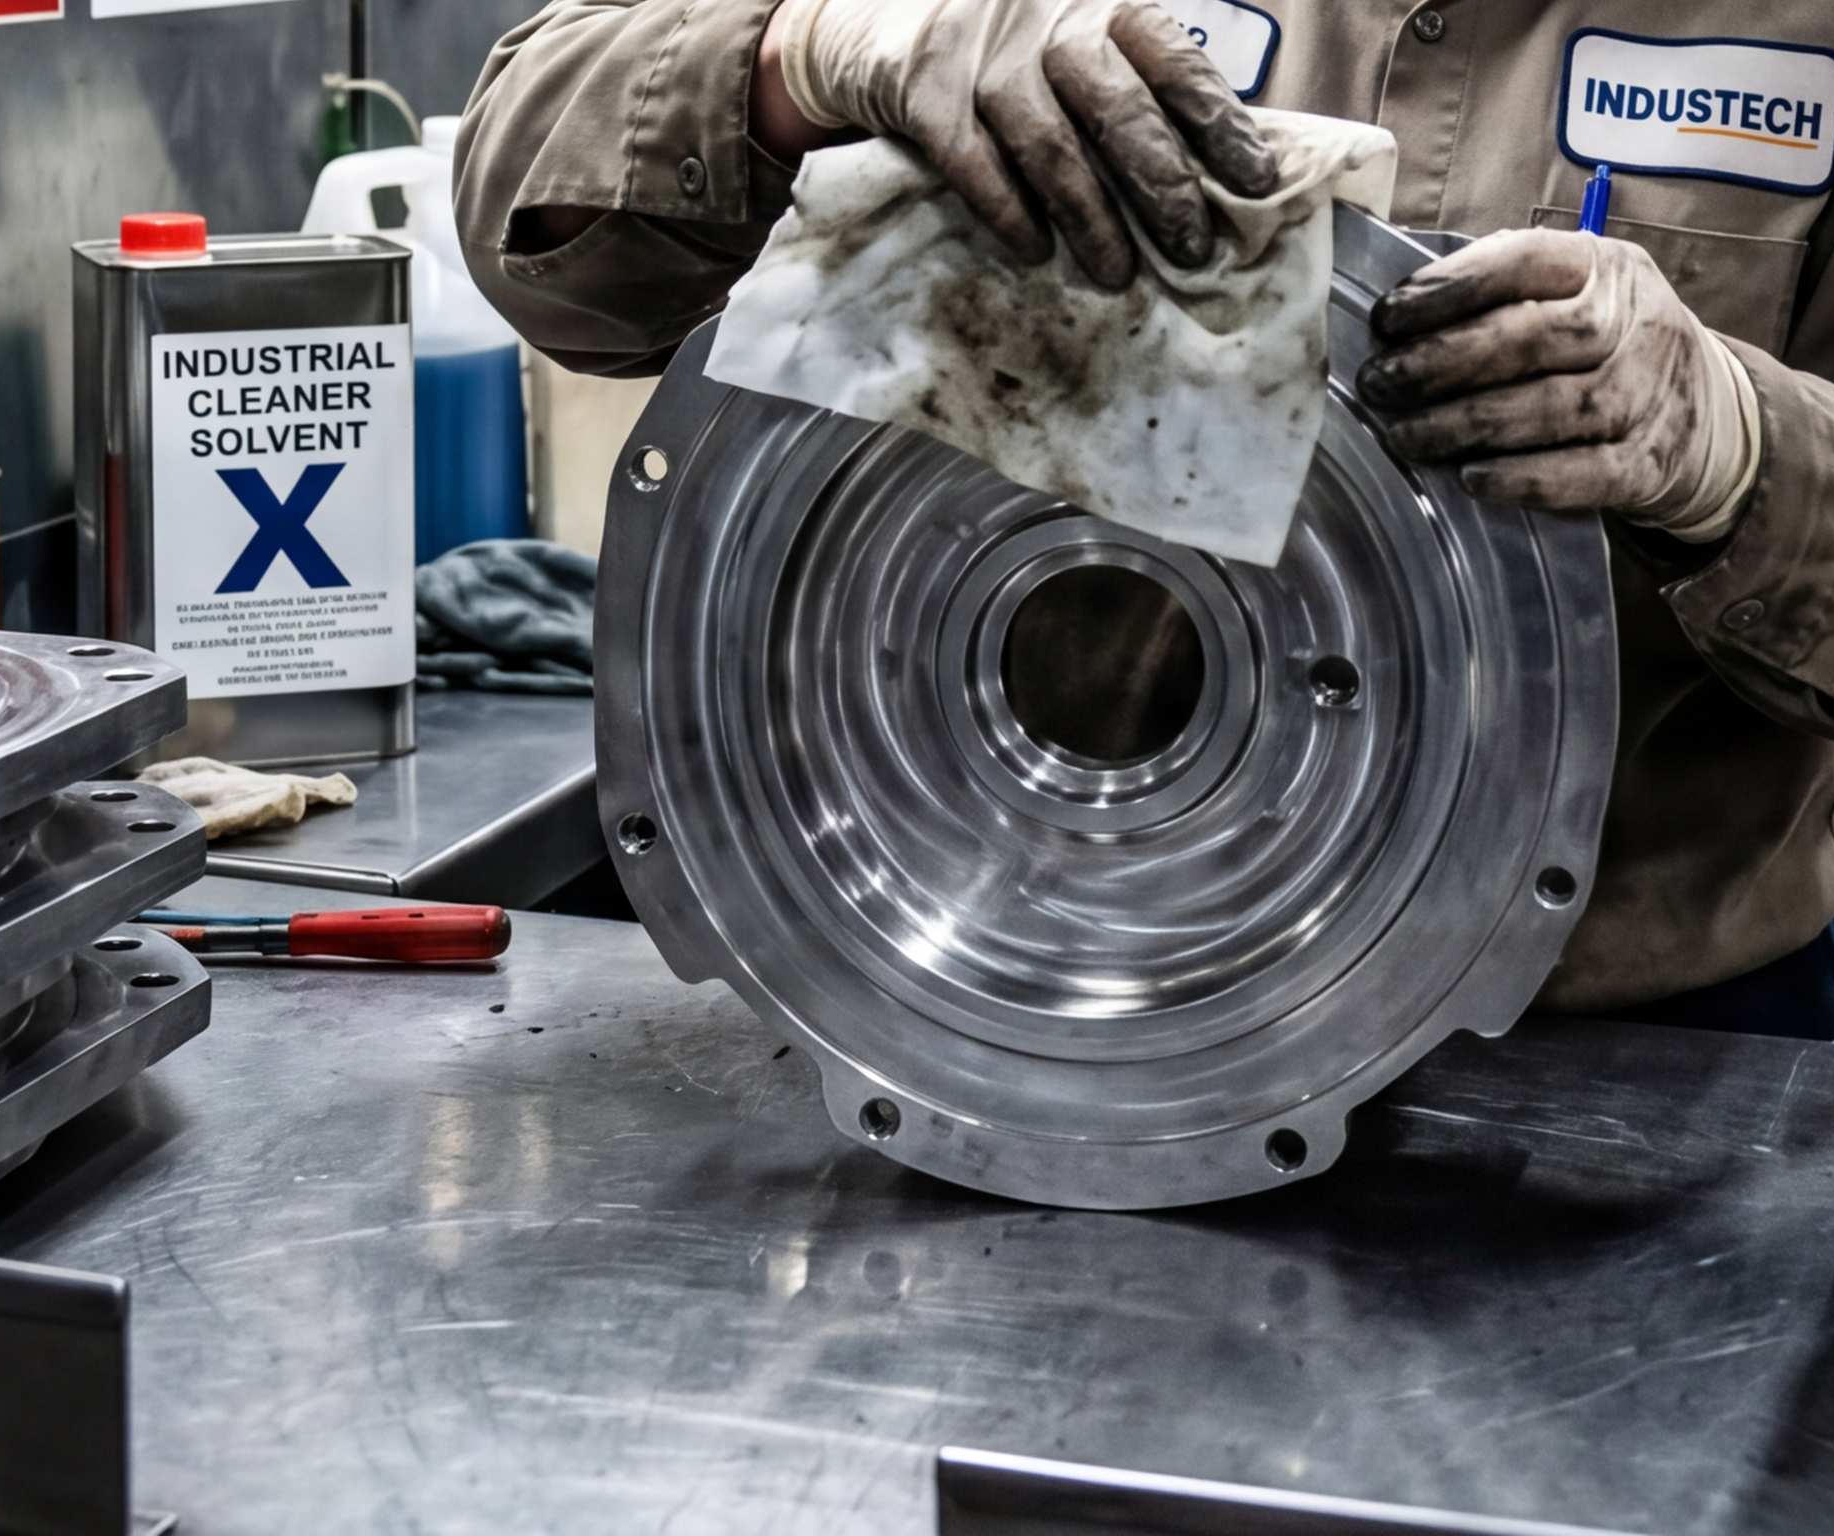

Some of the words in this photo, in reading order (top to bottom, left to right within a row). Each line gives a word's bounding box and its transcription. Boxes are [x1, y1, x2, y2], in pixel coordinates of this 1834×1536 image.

[1584, 77, 1823, 141] INDUSTECH
[163, 341, 395, 379] INDUSTRIAL
[188, 381, 372, 418] CLEANER
[190, 420, 369, 458] SOLVENT
[214, 462, 352, 595] X
